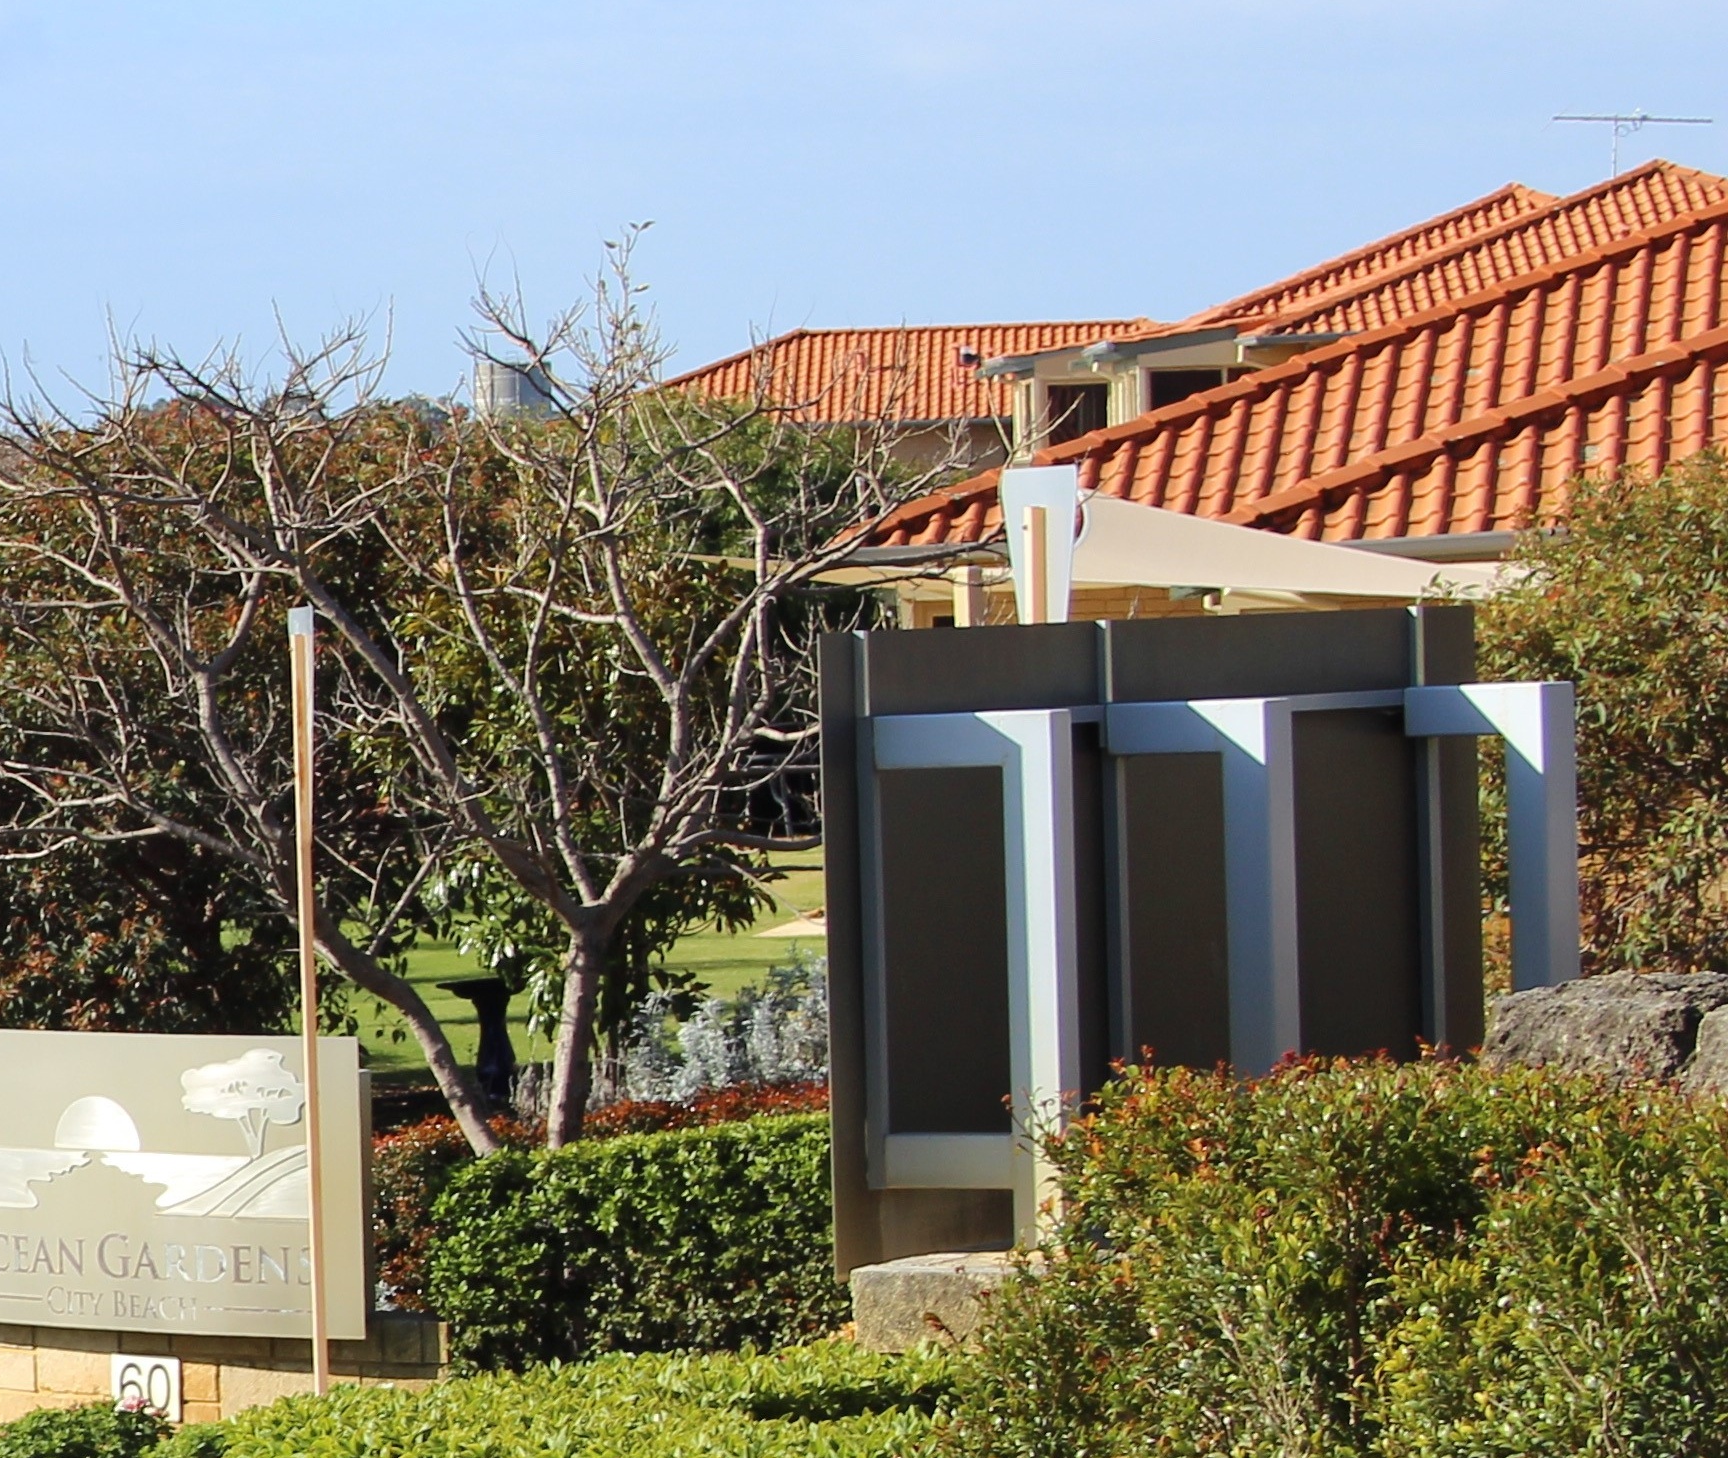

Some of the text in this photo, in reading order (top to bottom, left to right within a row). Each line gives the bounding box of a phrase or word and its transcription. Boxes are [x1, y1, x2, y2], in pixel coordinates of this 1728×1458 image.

[46, 1285, 198, 1321] CITY BEACH
[119, 1362, 171, 1412] 60
